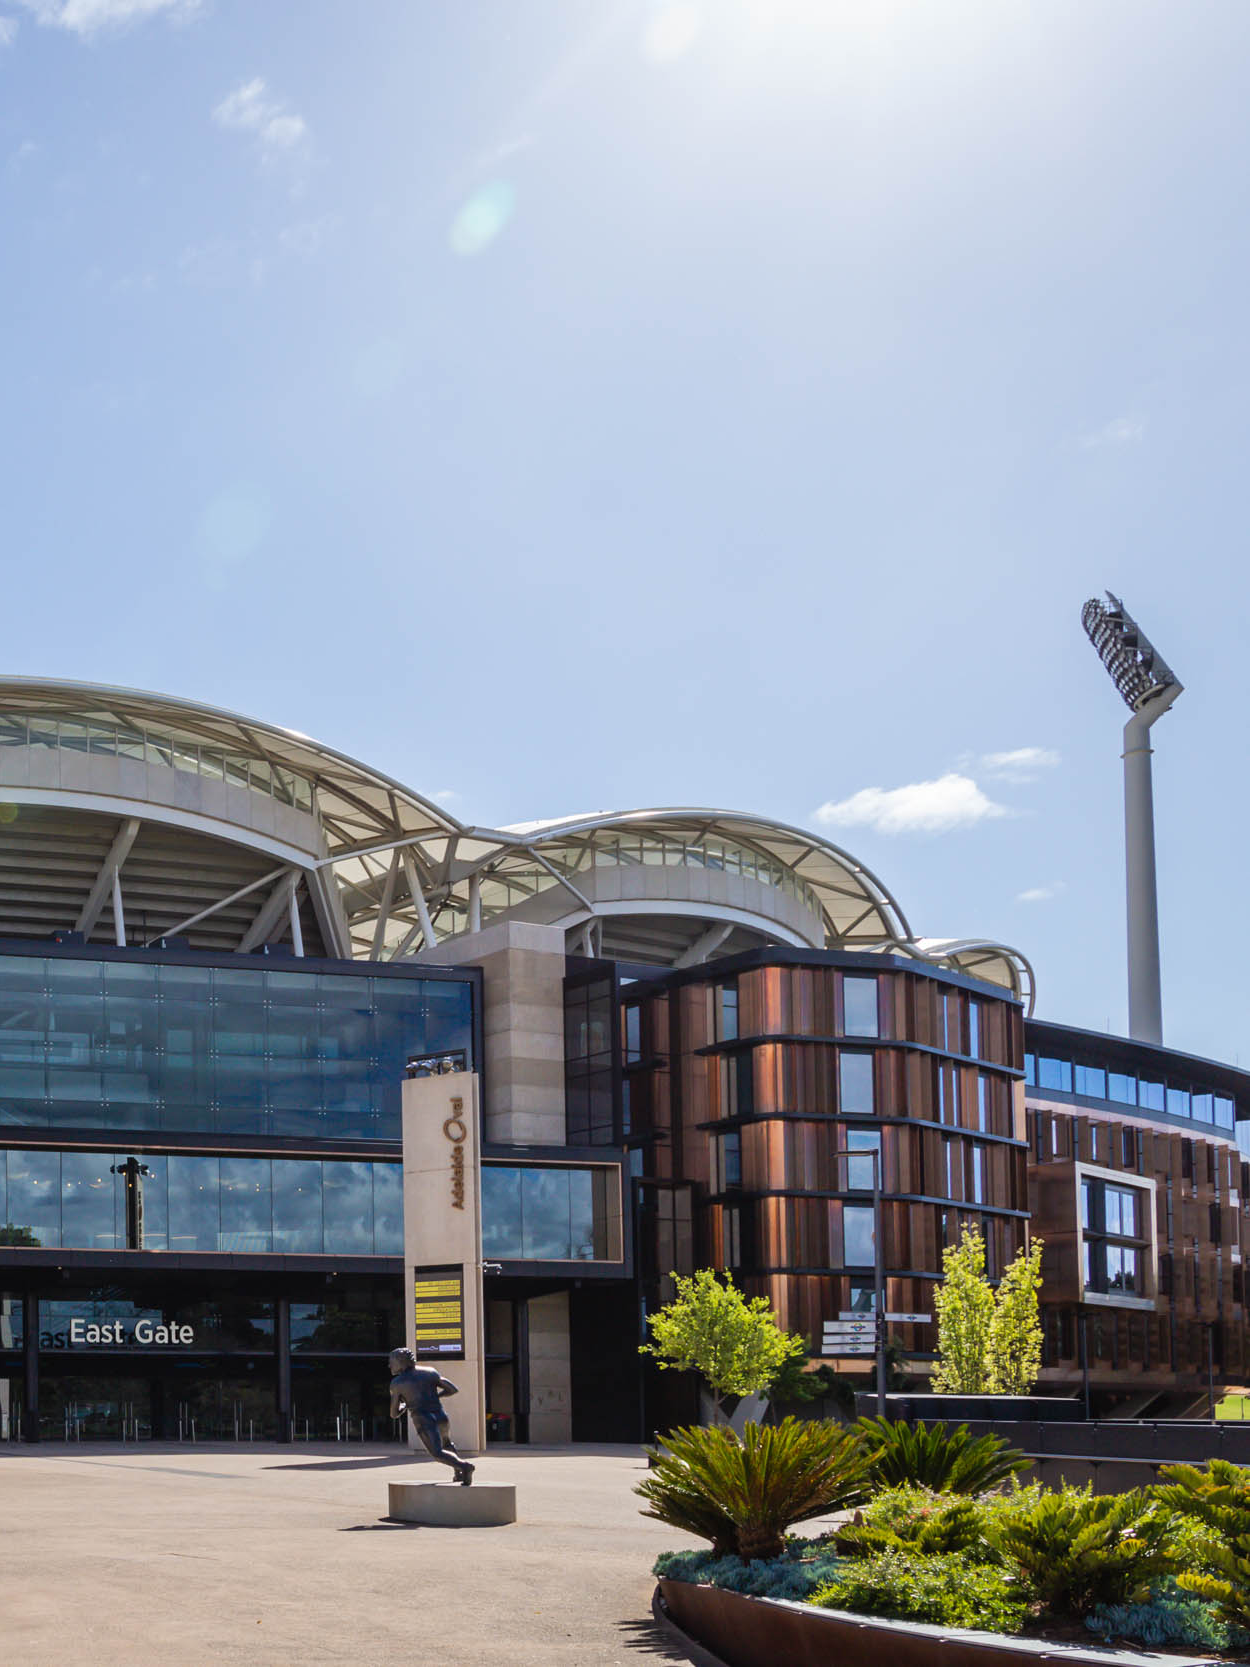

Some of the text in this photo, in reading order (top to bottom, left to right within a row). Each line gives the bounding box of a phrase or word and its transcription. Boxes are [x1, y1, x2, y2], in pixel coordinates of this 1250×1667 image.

[443, 1097, 467, 1210] Adelaide Oval
[70, 1318, 194, 1344] East Gate
